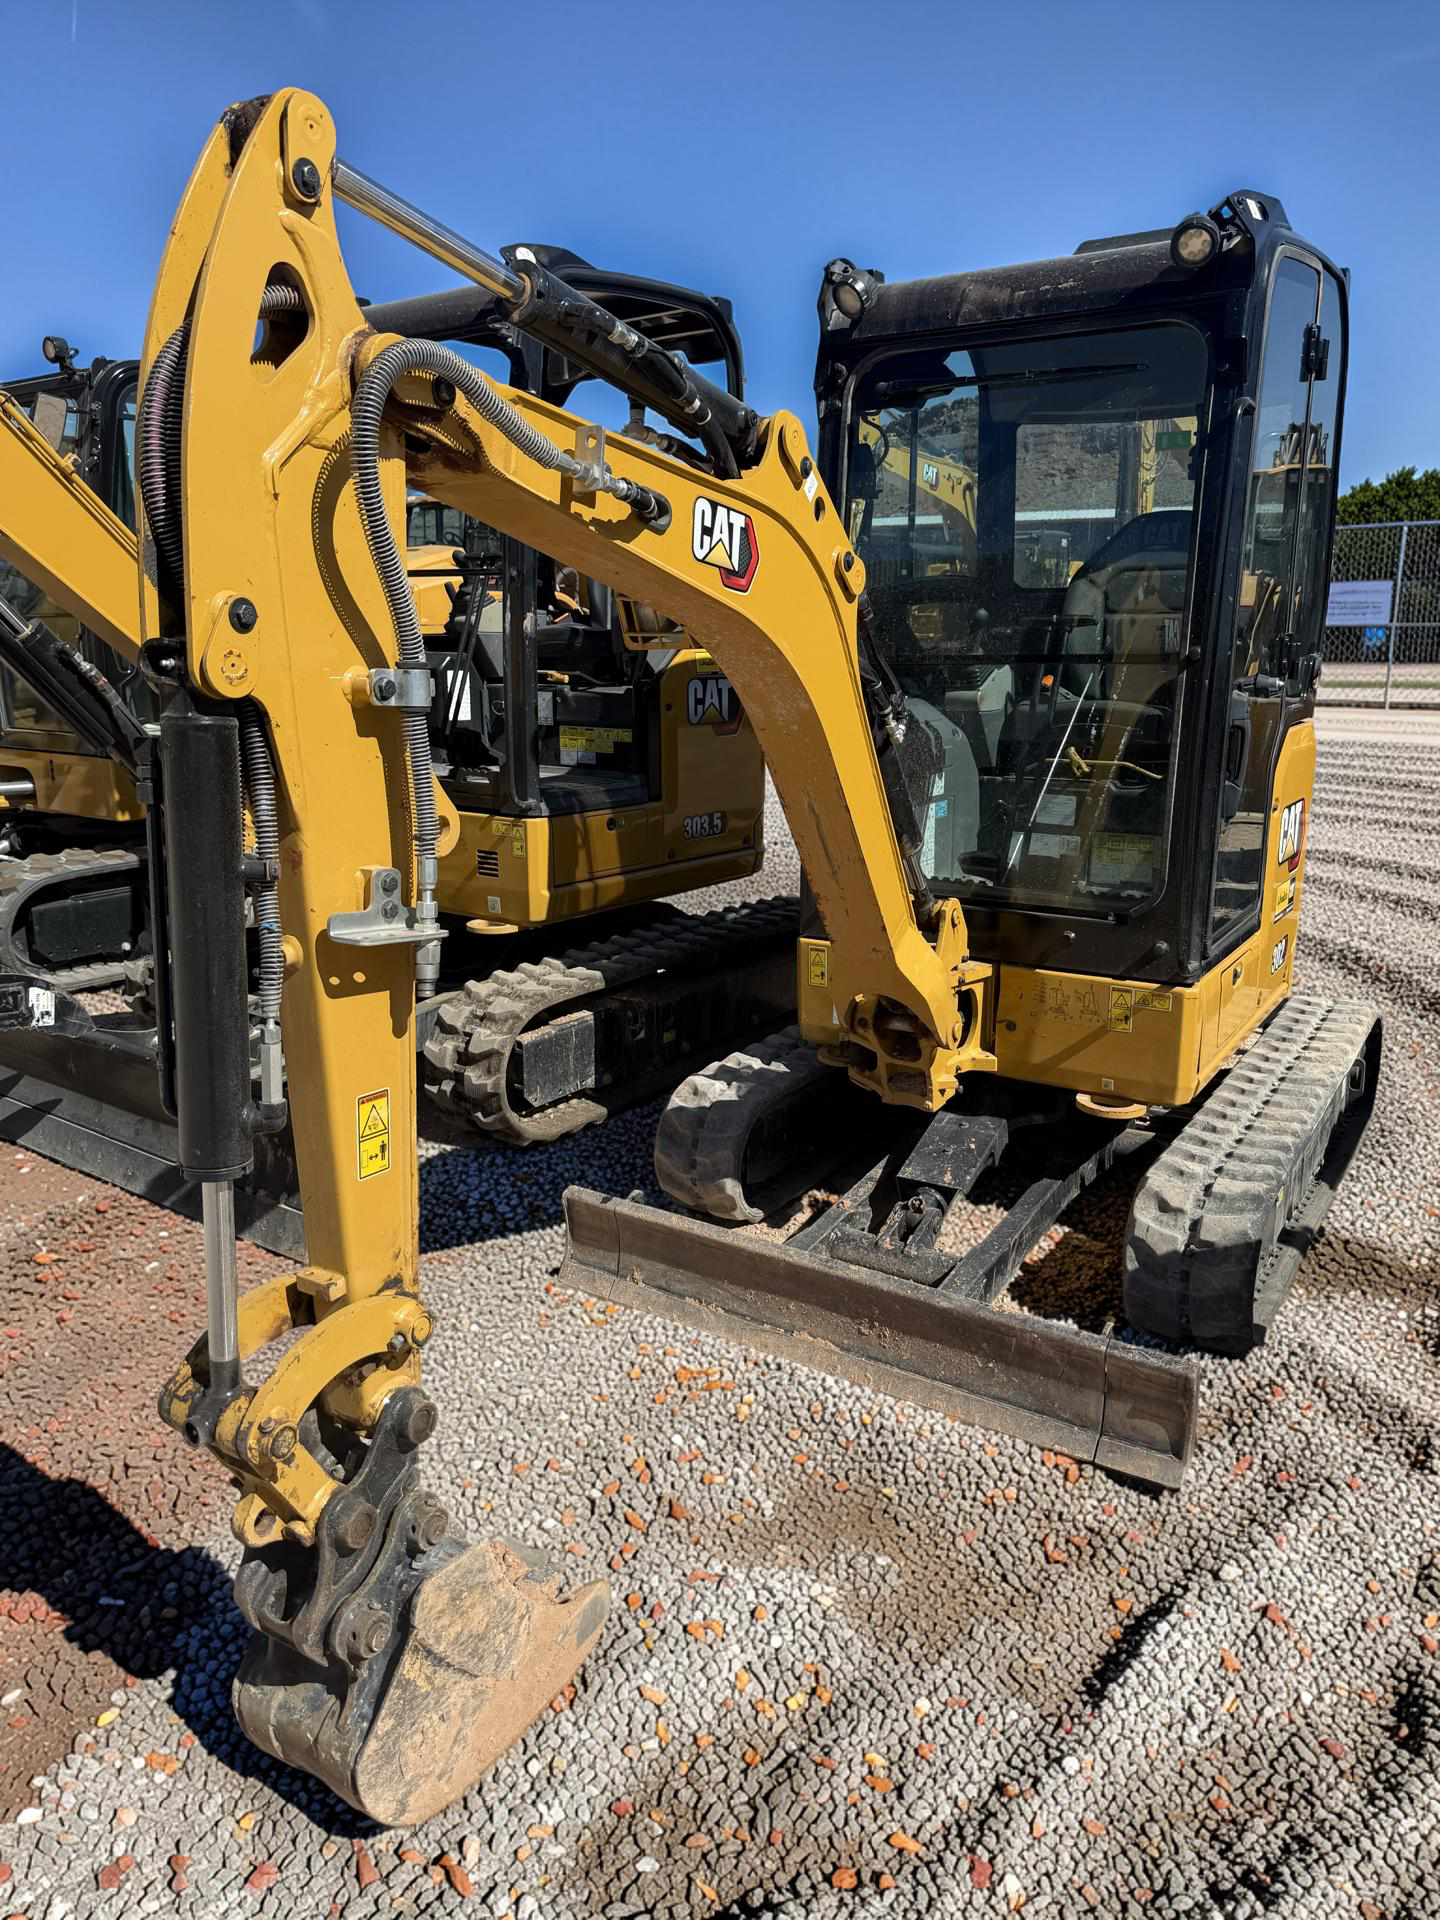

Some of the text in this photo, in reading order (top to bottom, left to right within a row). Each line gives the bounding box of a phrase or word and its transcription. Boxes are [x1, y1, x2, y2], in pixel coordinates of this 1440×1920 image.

[923, 463, 938, 486] CAT
[693, 497, 746, 572] CAT
[687, 679, 732, 724] CAT
[683, 811, 722, 839] 303.5
[1278, 800, 1303, 864] CAT
[1271, 937, 1286, 975] 302
